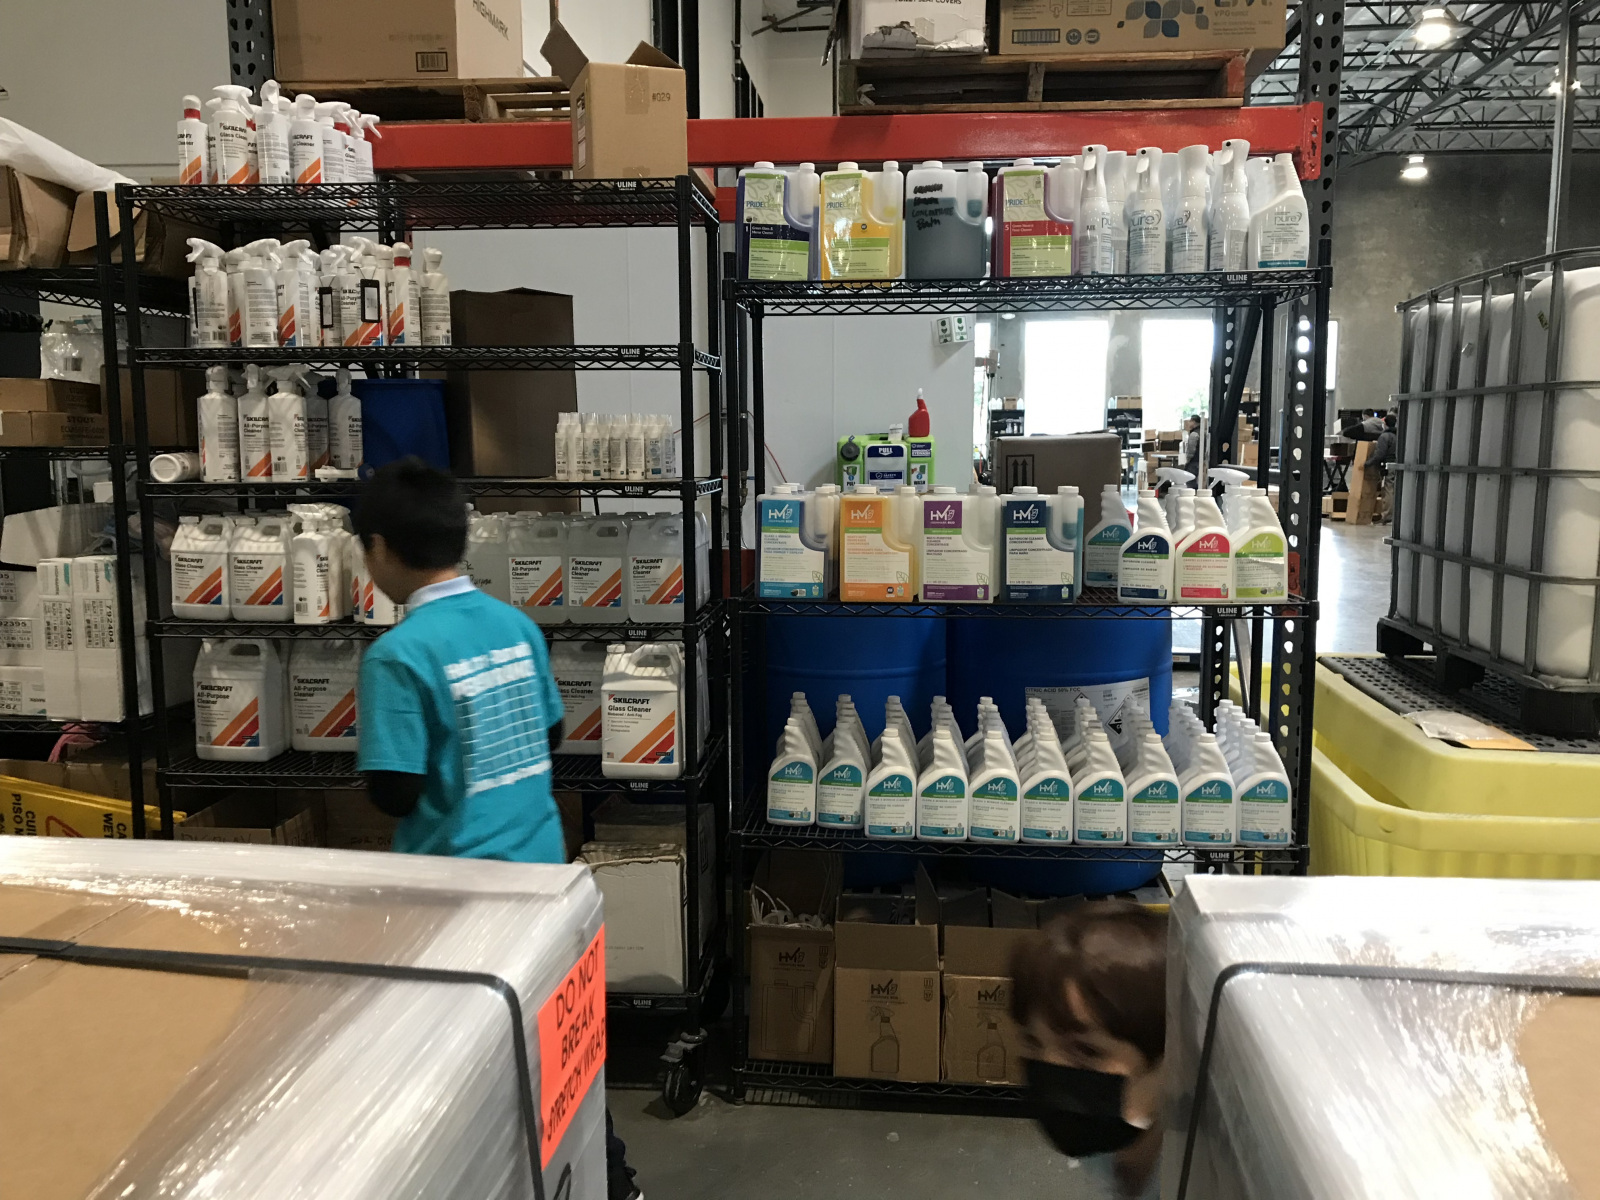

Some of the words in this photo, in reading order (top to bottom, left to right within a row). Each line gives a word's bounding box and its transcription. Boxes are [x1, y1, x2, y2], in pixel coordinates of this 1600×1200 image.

[930, 504, 951, 520] HM
[1014, 504, 1035, 520] HM
[106, 605, 114, 643] 792404
[613, 696, 650, 705] SKILCRAFT
[627, 705, 652, 713] Cleaner
[12, 793, 23, 824] PISO
[556, 978, 575, 1030] DO
[578, 942, 599, 992] NOT
[871, 978, 893, 995] HM
[978, 985, 1001, 1001] HM
[562, 988, 595, 1070] BREAK
[548, 1064, 582, 1142] STRETCH
